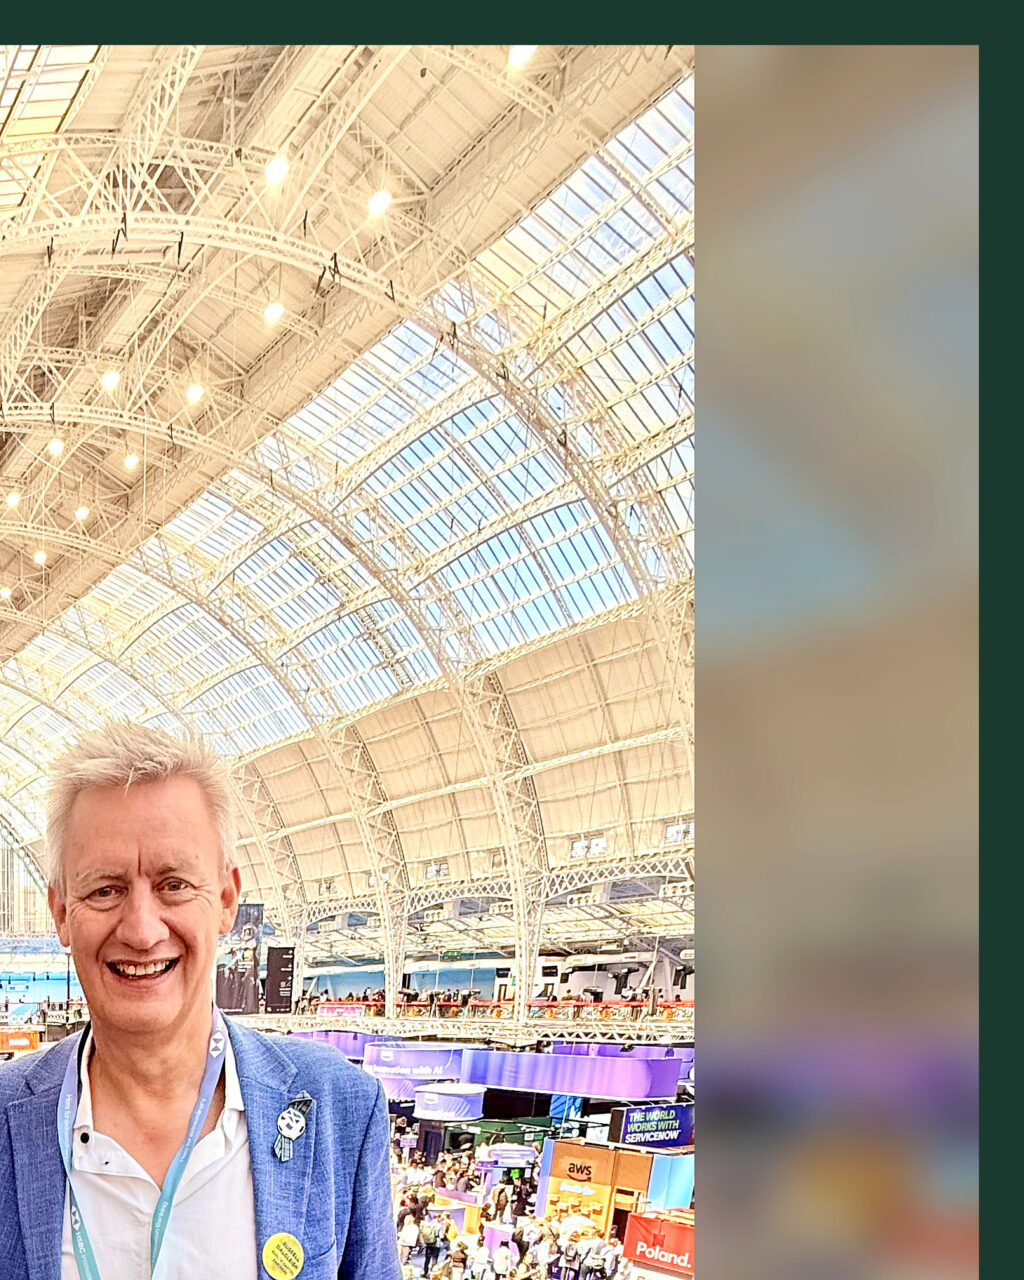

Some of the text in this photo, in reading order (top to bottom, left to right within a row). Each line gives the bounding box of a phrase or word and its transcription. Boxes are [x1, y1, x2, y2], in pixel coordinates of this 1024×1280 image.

[629, 1109, 676, 1122] THE WORLD
[627, 1119, 680, 1132] WORKS WITH
[625, 1129, 681, 1143] SERVICENOW
[568, 1162, 592, 1176] aws
[636, 1242, 692, 1269] Poland.
